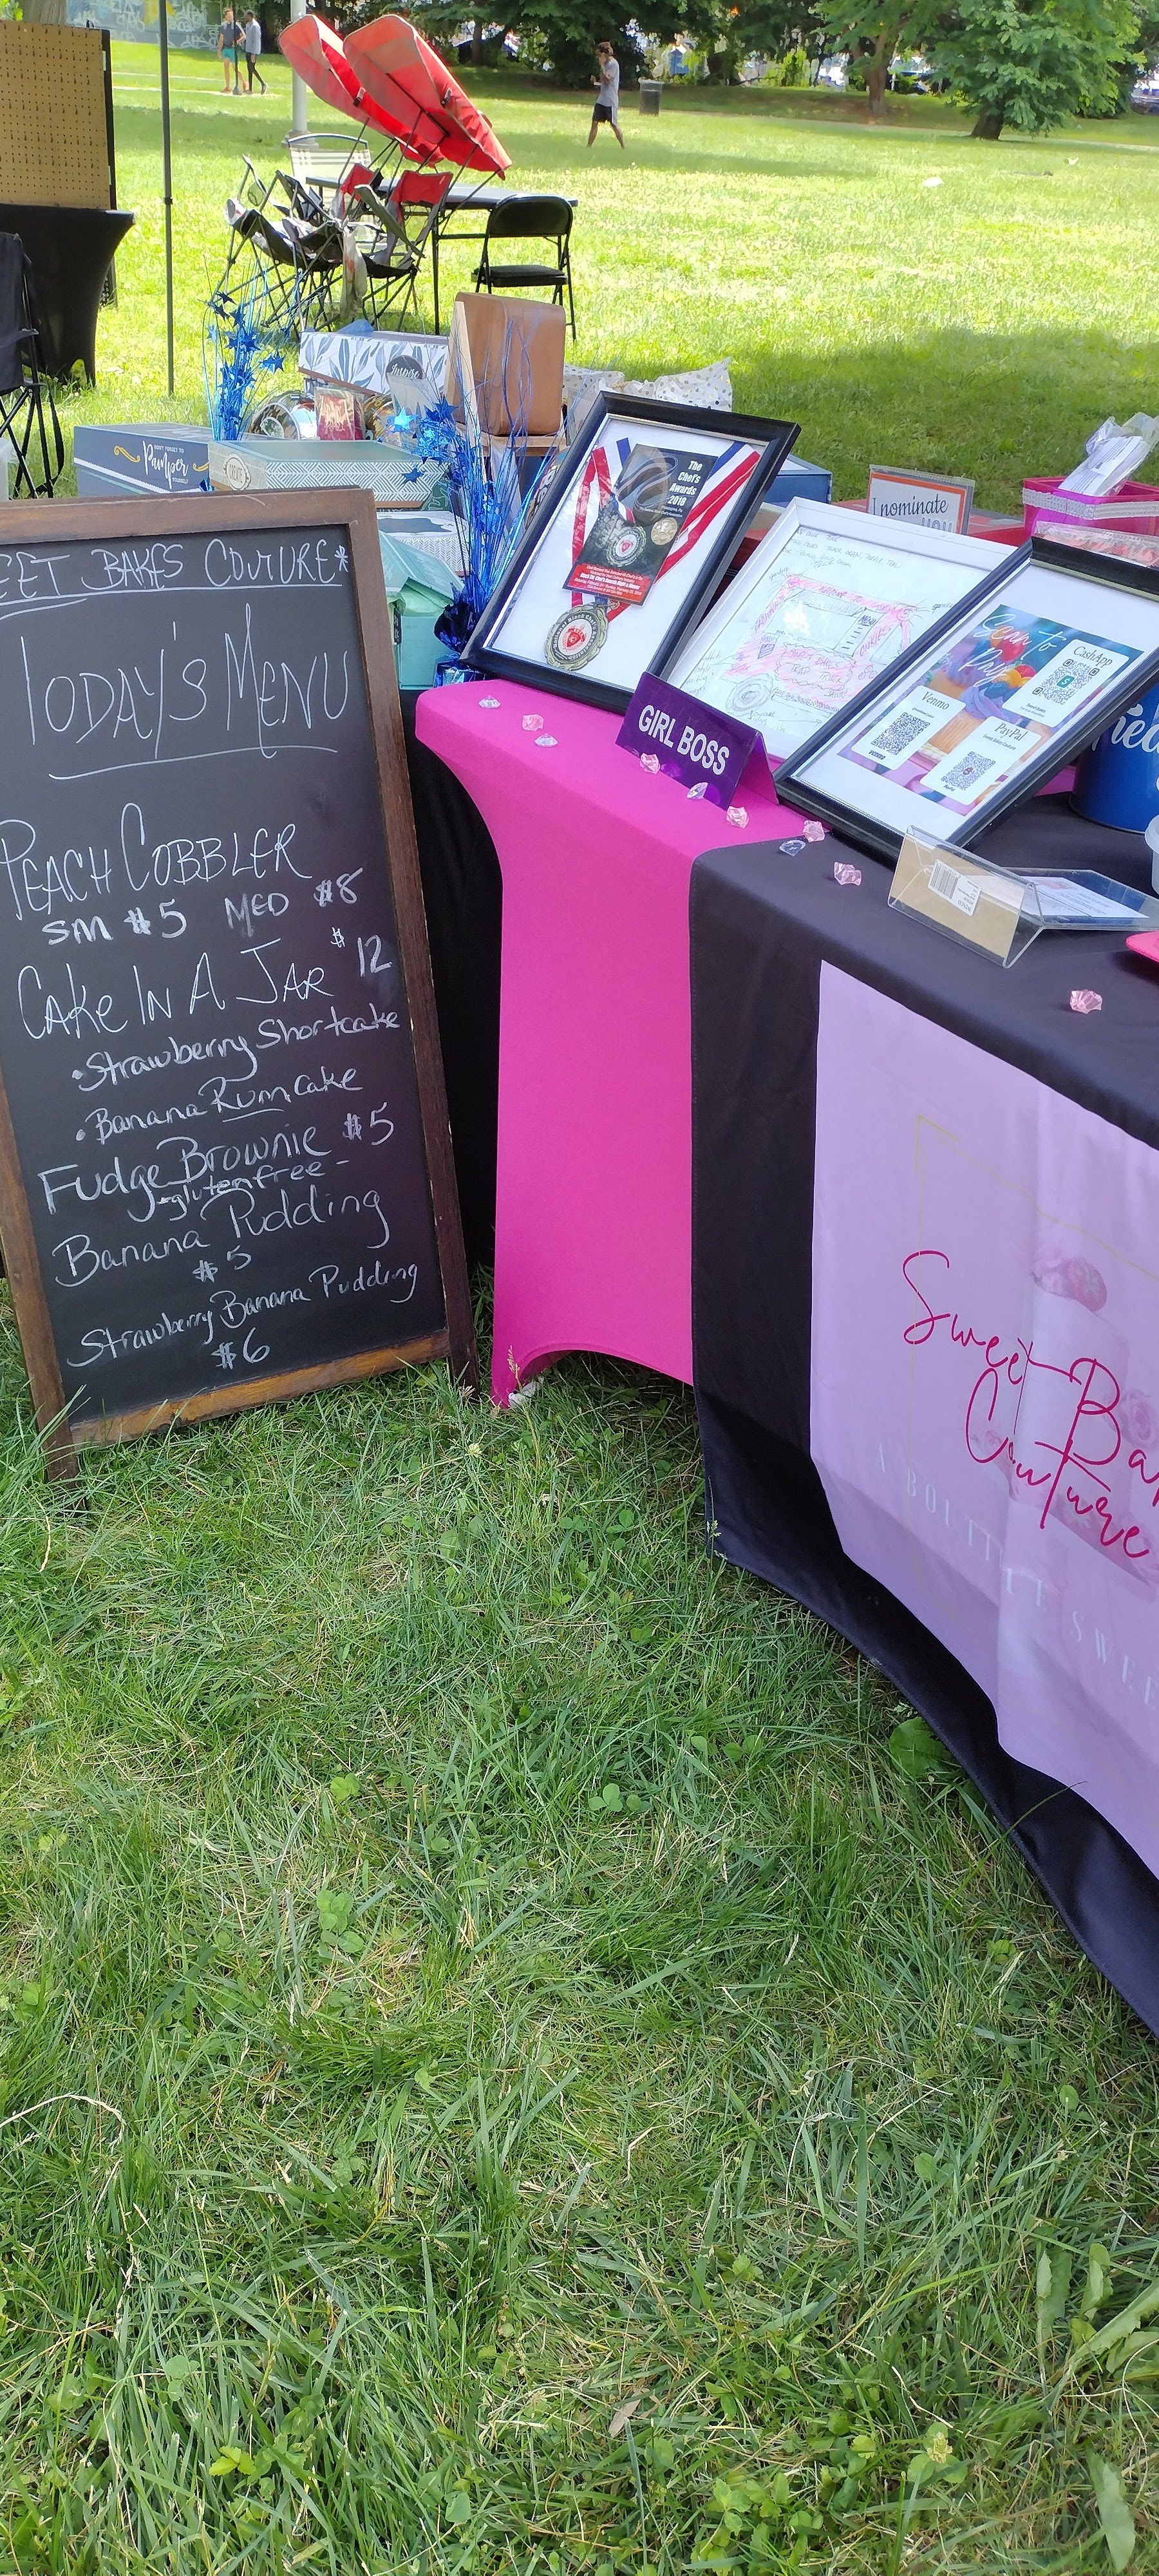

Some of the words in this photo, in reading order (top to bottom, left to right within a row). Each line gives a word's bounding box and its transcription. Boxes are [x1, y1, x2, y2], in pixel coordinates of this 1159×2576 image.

[142, 440, 189, 489] Pamper
[678, 471, 701, 484] Chef's
[688, 460, 702, 471] The
[668, 495, 687, 506] 2018
[669, 483, 697, 495] Awards
[872, 497, 876, 515] I
[880, 493, 949, 517] nominate
[81, 543, 184, 590] BAKES
[567, 613, 585, 623] Black
[858, 614, 877, 625] MENU
[973, 614, 1032, 645] Scan
[787, 661, 811, 676] TRAP
[959, 647, 1008, 689] Pay
[1073, 645, 1113, 668] CashApp
[225, 603, 348, 759] MENU
[922, 691, 950, 710] Venmo
[638, 705, 676, 748] GIRL
[677, 725, 730, 775] BOSS
[995, 722, 1028, 741] PayPal
[0, 819, 112, 920] PEACH
[120, 802, 313, 891] COBBLER
[225, 893, 290, 937] MED
[133, 964, 173, 1026] IN
[190, 951, 225, 1015] A
[236, 938, 335, 1005] JAR
[256, 1002, 401, 1049] Shortcake
[85, 1100, 209, 1144] Banana
[37, 1157, 170, 1223] Fudge
[156, 1123, 332, 1185] Brownie
[52, 1229, 211, 1288] Banana
[200, 1184, 391, 1249] Pudding
[66, 1308, 217, 1368] Strawberry
[209, 1286, 312, 1330] Banana
[308, 1260, 419, 1303] Pudding
[903, 1249, 1080, 1435] Sweet
[1068, 1358, 1159, 1508] Ba
[966, 1368, 1149, 1558] Couture
